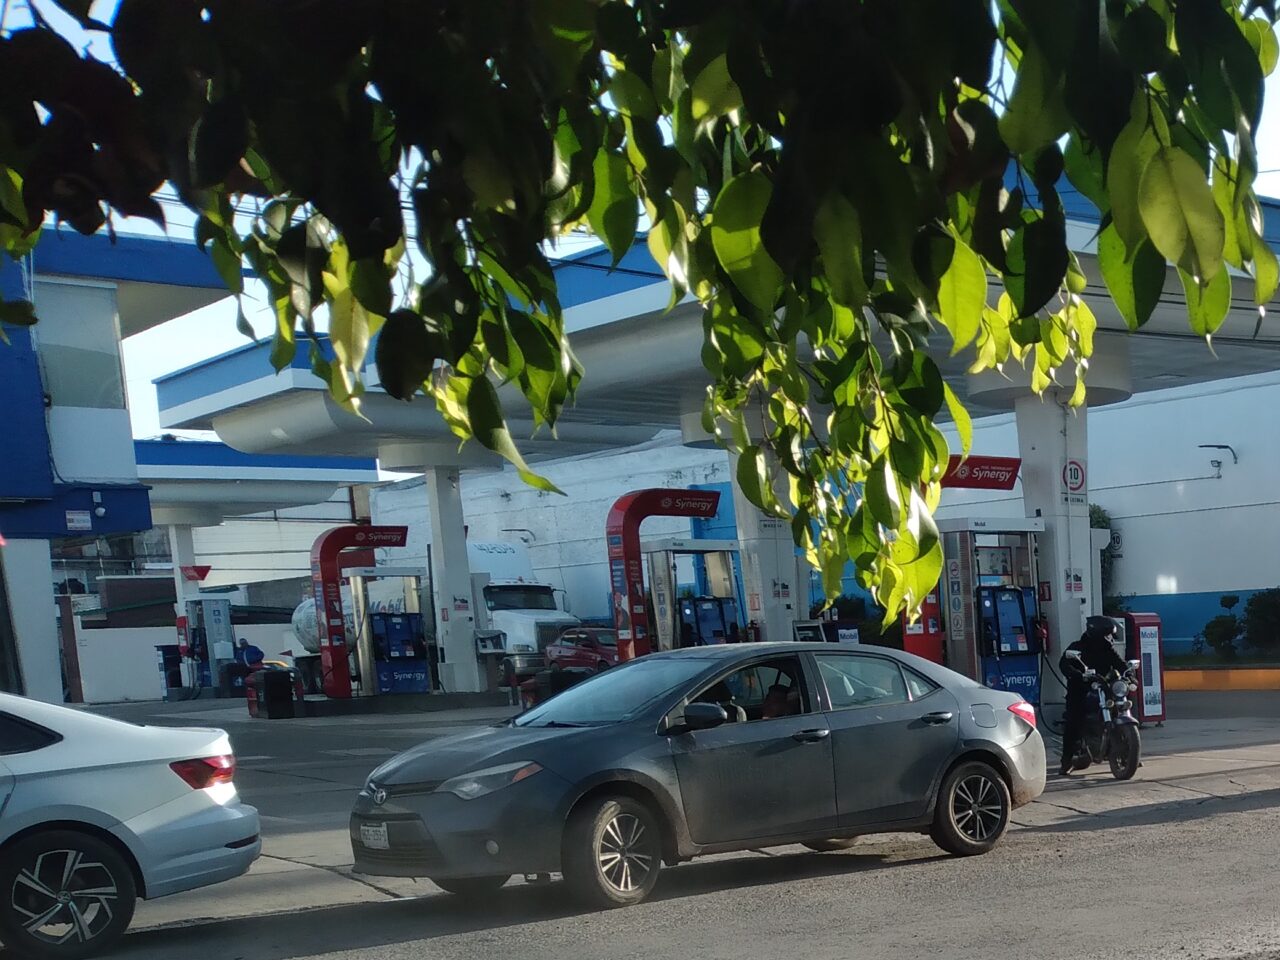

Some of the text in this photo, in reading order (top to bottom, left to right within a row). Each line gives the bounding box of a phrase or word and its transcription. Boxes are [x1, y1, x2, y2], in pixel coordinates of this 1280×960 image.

[972, 467, 1012, 482] Synergy
[1069, 466, 1079, 481] 10
[675, 498, 713, 511] Synergy
[368, 532, 402, 543] Synergy
[1112, 535, 1121, 545] 10
[840, 632, 858, 640] Mobil
[1141, 630, 1157, 639] Mobil
